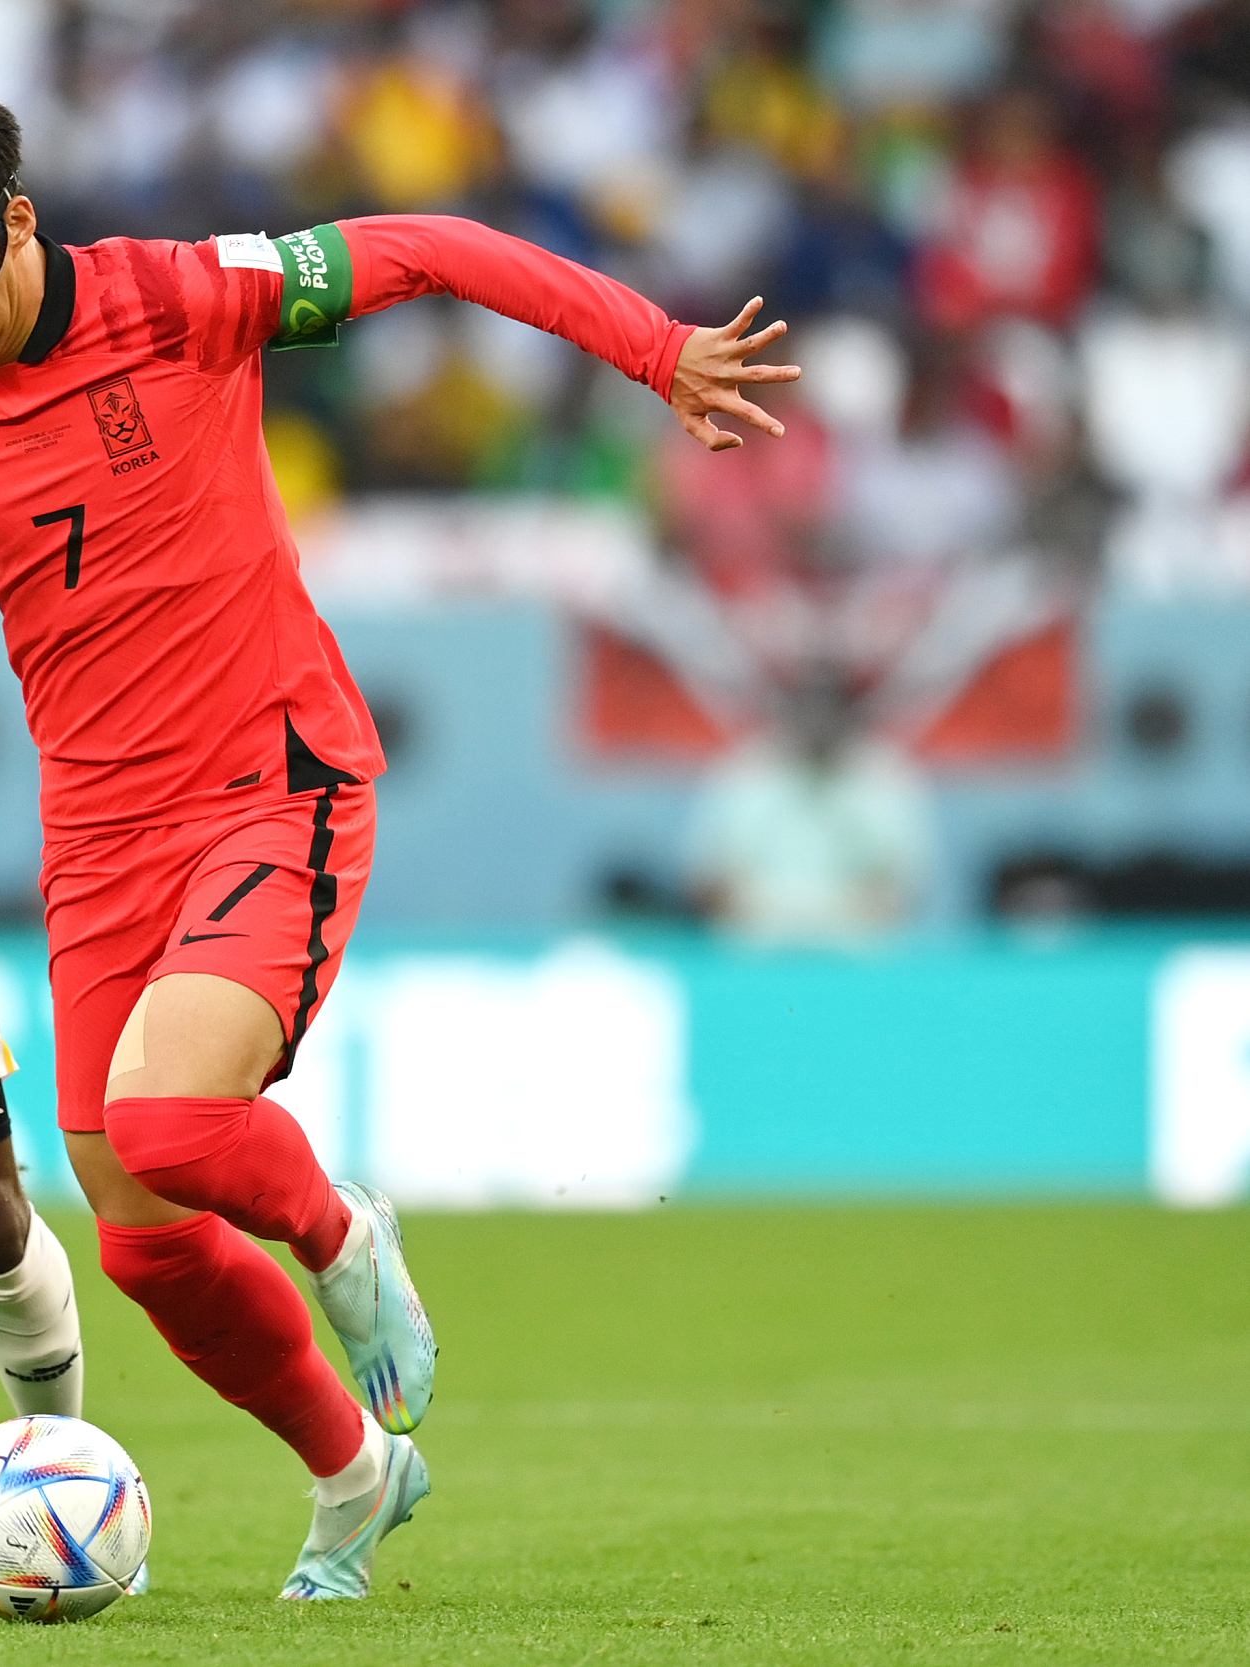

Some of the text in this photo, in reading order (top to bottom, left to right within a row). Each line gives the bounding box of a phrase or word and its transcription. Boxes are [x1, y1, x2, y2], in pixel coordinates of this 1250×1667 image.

[289, 244, 311, 287] SAVE
[111, 450, 160, 476] KOREA
[31, 504, 85, 589] 7
